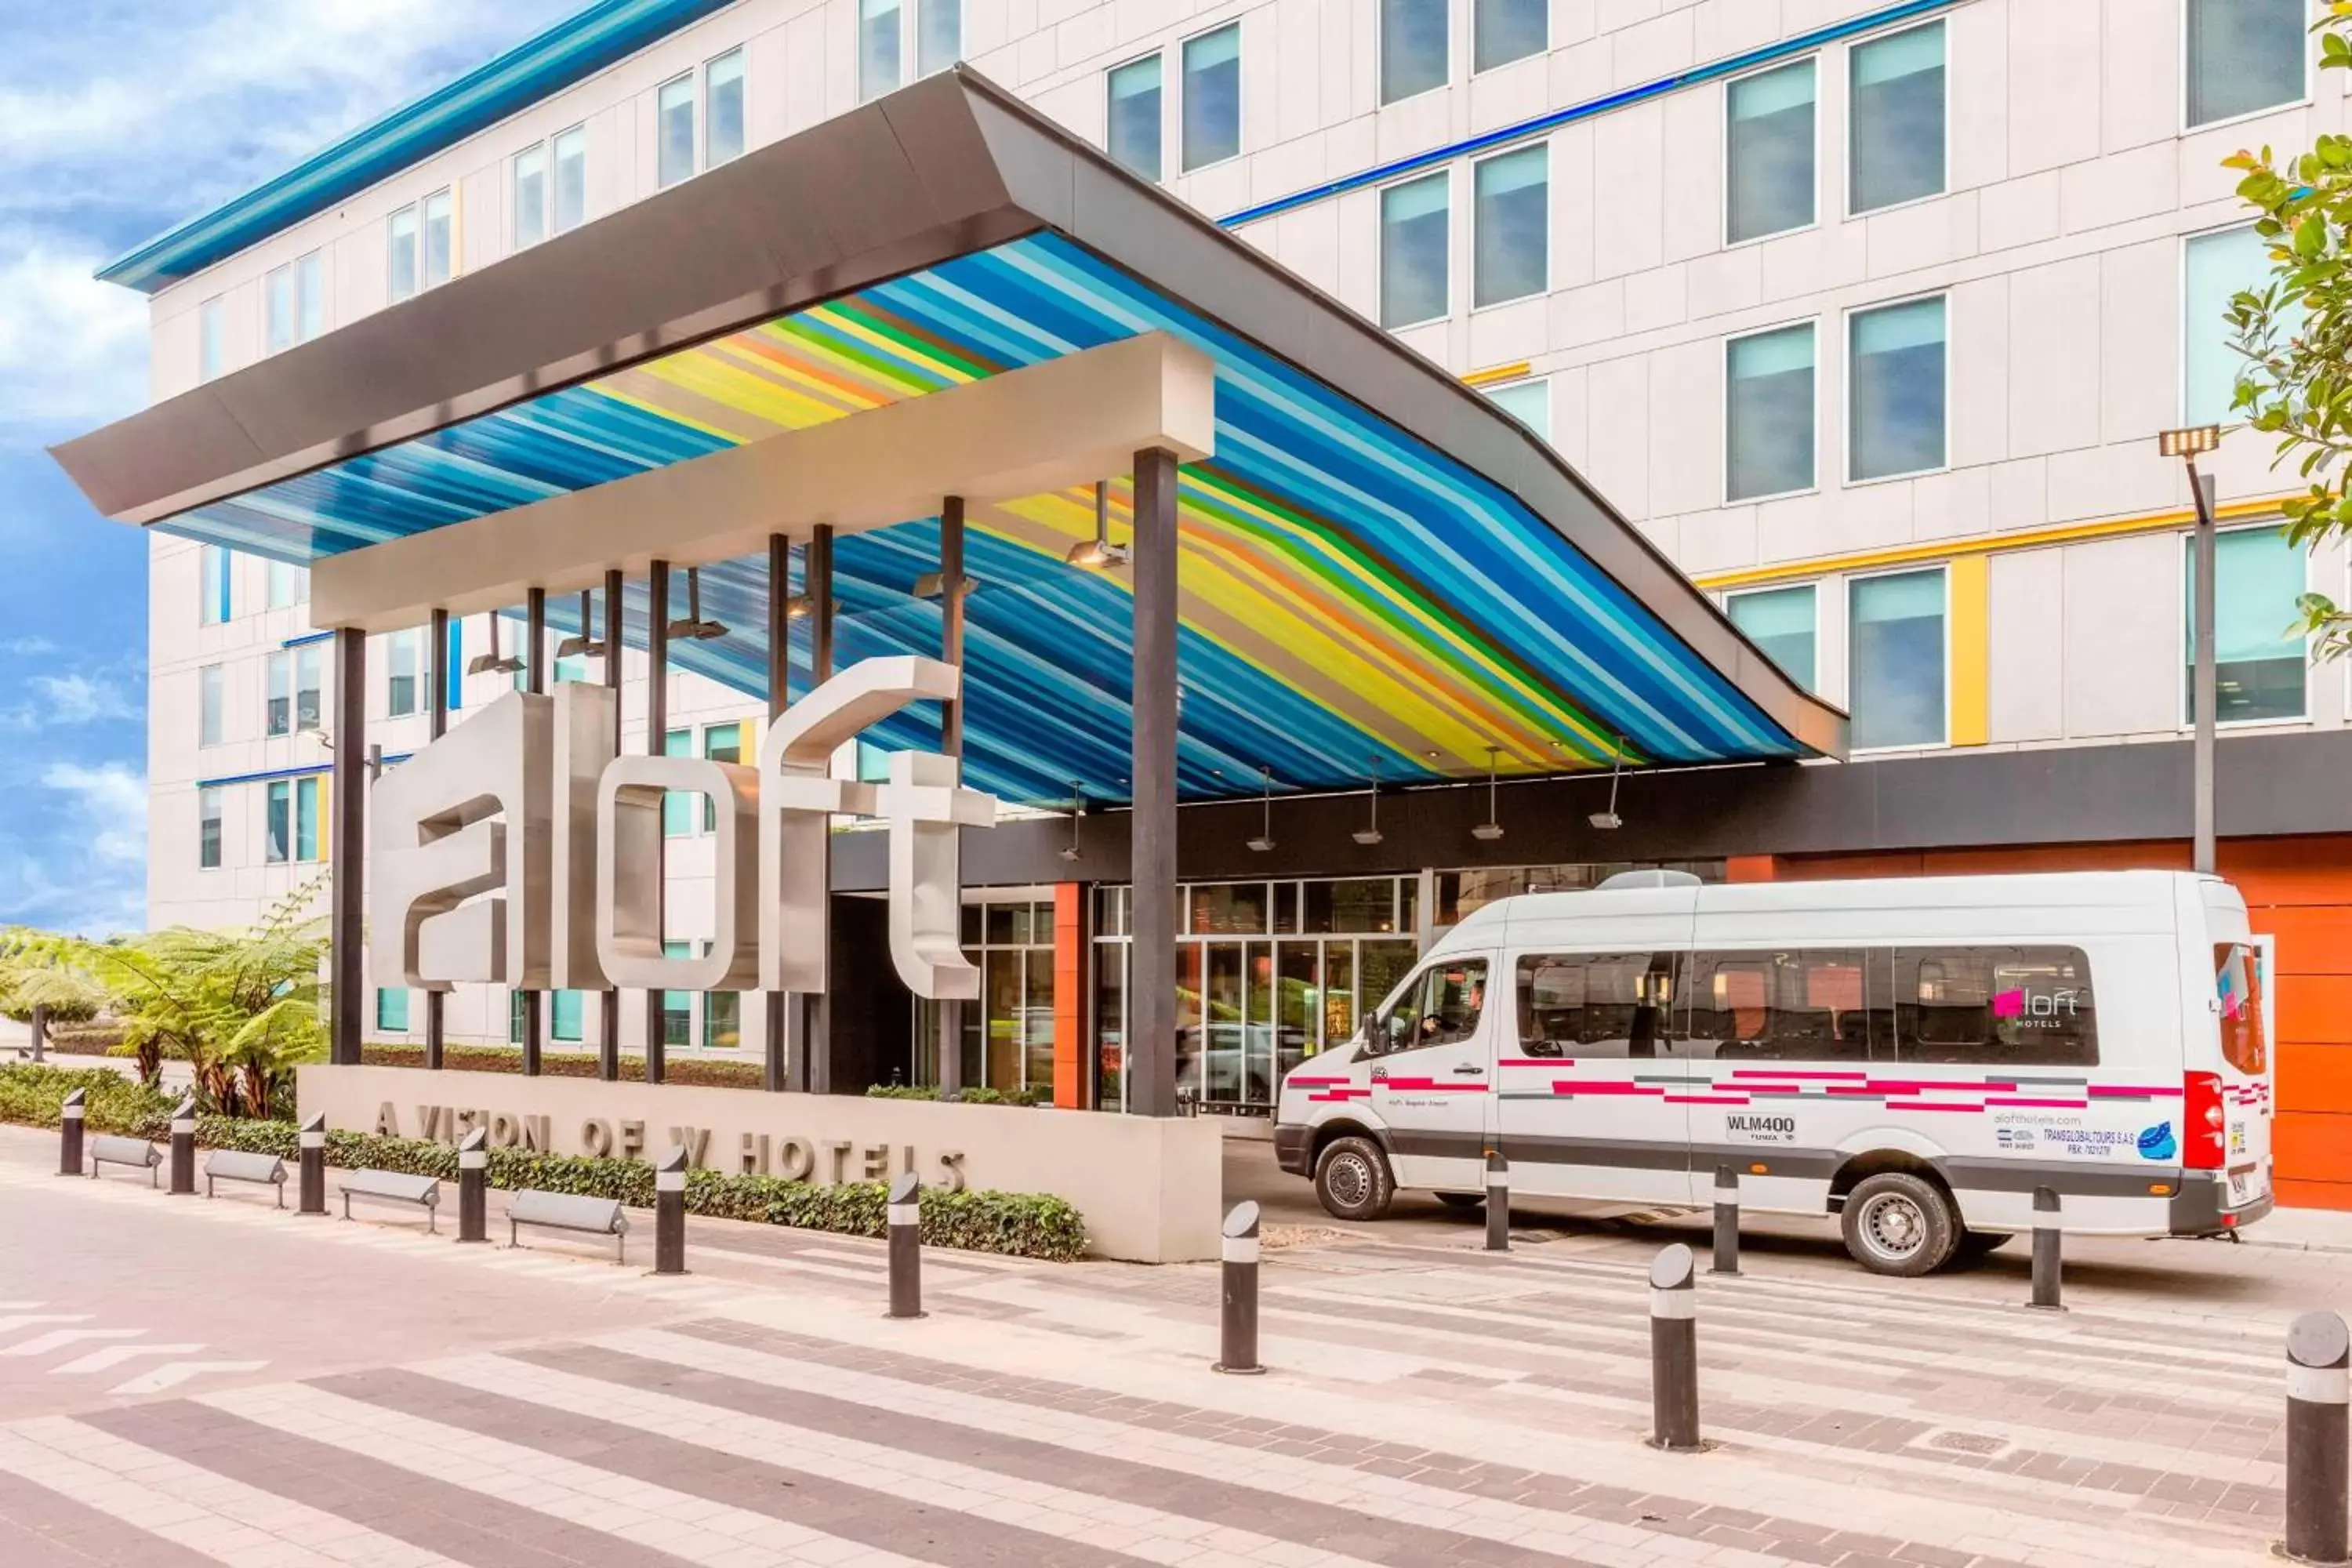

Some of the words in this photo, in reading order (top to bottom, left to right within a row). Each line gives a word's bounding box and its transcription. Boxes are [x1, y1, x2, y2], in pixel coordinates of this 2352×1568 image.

[369, 655, 996, 1000] aloft
[1994, 989, 2078, 1016] loft
[2016, 1020, 2061, 1029] HOTELS
[1727, 1116, 1795, 1133] WLM400
[376, 1101, 399, 1138] A
[416, 1105, 551, 1154] VISION
[579, 1116, 644, 1160] OF
[668, 1126, 711, 1168] W
[739, 1132, 965, 1193] HOTELS
